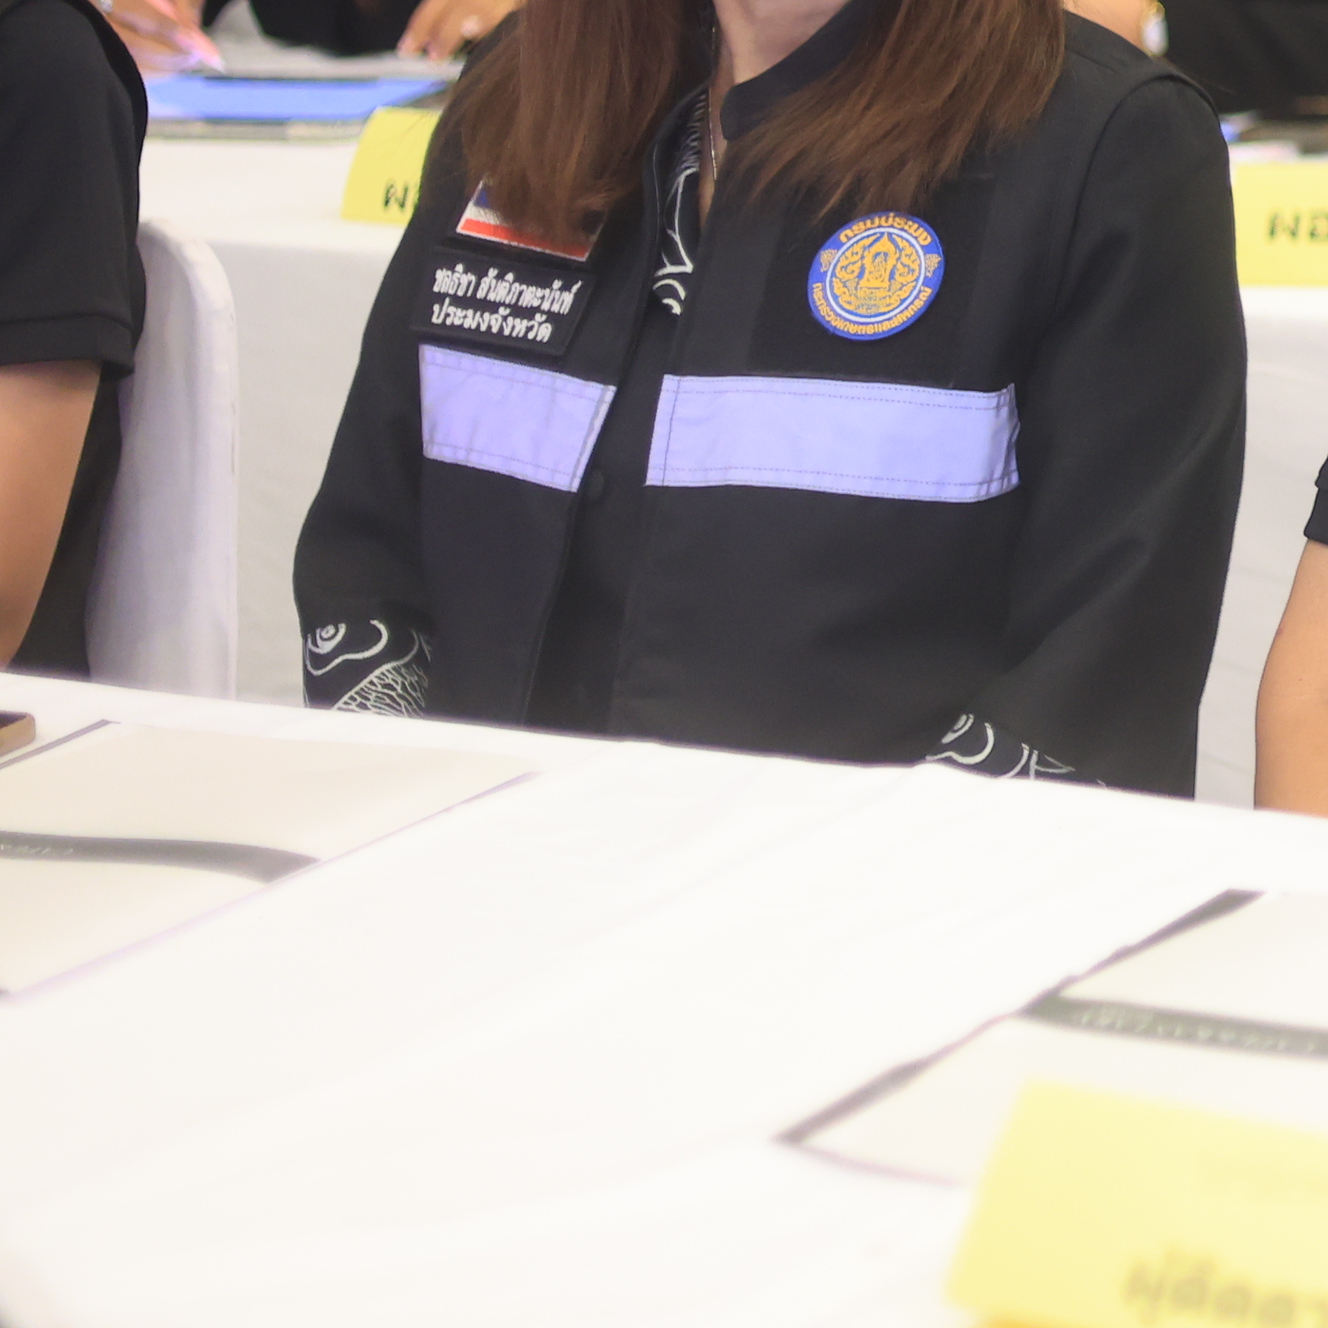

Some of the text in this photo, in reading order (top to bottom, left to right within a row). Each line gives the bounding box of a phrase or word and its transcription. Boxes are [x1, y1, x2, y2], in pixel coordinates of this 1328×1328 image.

[838, 212, 932, 246] กรมประมง
[430, 296, 553, 343] ประมงจังหวัด
